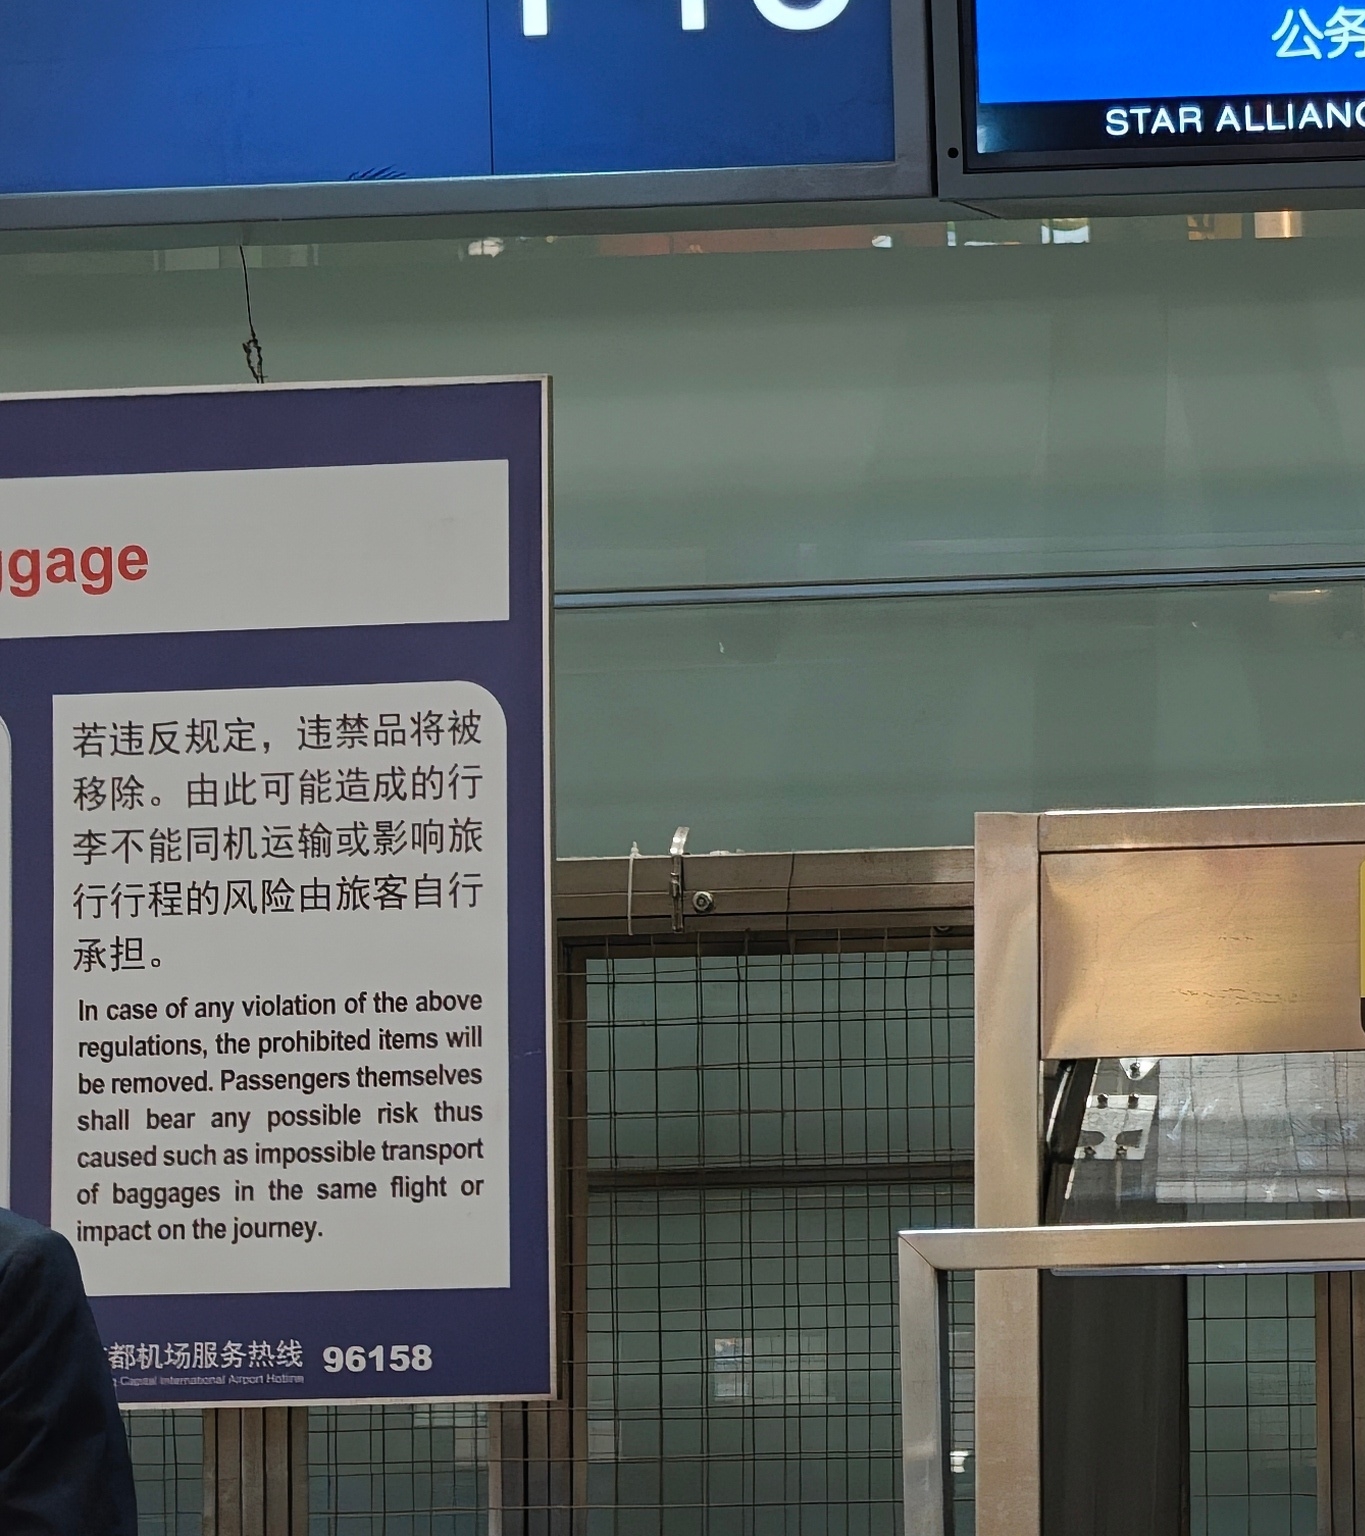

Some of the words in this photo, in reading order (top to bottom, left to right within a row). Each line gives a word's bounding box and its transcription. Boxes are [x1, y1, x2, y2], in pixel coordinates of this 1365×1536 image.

[1106, 107, 1202, 135] STAR
[0, 545, 148, 598] gage
[73, 709, 483, 758] 若违反规定，违禁品将被
[73, 763, 483, 812] 移除。由此可能造成的行
[73, 817, 483, 866] 李不能同机运输或影响旅
[73, 872, 484, 920] 行行程的风险由旅客自行
[73, 936, 162, 973] 承担。
[79, 1000, 97, 1021] In
[107, 1003, 157, 1020] case
[166, 997, 188, 1018] of
[195, 1001, 234, 1023] any
[242, 994, 335, 1016] violation
[345, 992, 367, 1014] of
[373, 991, 408, 1013] the
[416, 990, 482, 1012] above
[79, 1034, 207, 1063] regulations,
[215, 1032, 250, 1054] the
[259, 1028, 370, 1059] prohibited
[379, 1028, 438, 1050] items
[446, 1025, 481, 1047] will
[79, 1073, 105, 1094] be
[112, 1070, 213, 1094] removed.
[221, 1070, 350, 1094] Passengers
[356, 1064, 482, 1087] themselves
[78, 1109, 129, 1131] shall
[147, 1108, 195, 1129] bear
[211, 1111, 251, 1133] any
[268, 1104, 361, 1132] possible
[378, 1102, 418, 1124] risk
[434, 1101, 482, 1122] thus
[78, 1145, 156, 1168] caused
[164, 1144, 216, 1166] such
[224, 1148, 248, 1165] as
[256, 1140, 375, 1169] impossible
[382, 1138, 483, 1165] transport
[77, 1183, 99, 1205] of
[113, 1182, 220, 1209] baggages
[236, 1180, 253, 1201] in
[268, 1179, 303, 1201] the
[317, 1182, 377, 1199] same
[391, 1175, 447, 1203] flight
[461, 1180, 484, 1196] or
[77, 1220, 151, 1246] impact
[158, 1224, 185, 1240] on
[192, 1218, 226, 1239] the
[232, 1217, 322, 1244] journey.
[103, 1339, 303, 1371] 都机场服务热线
[323, 1344, 433, 1373] 96158
